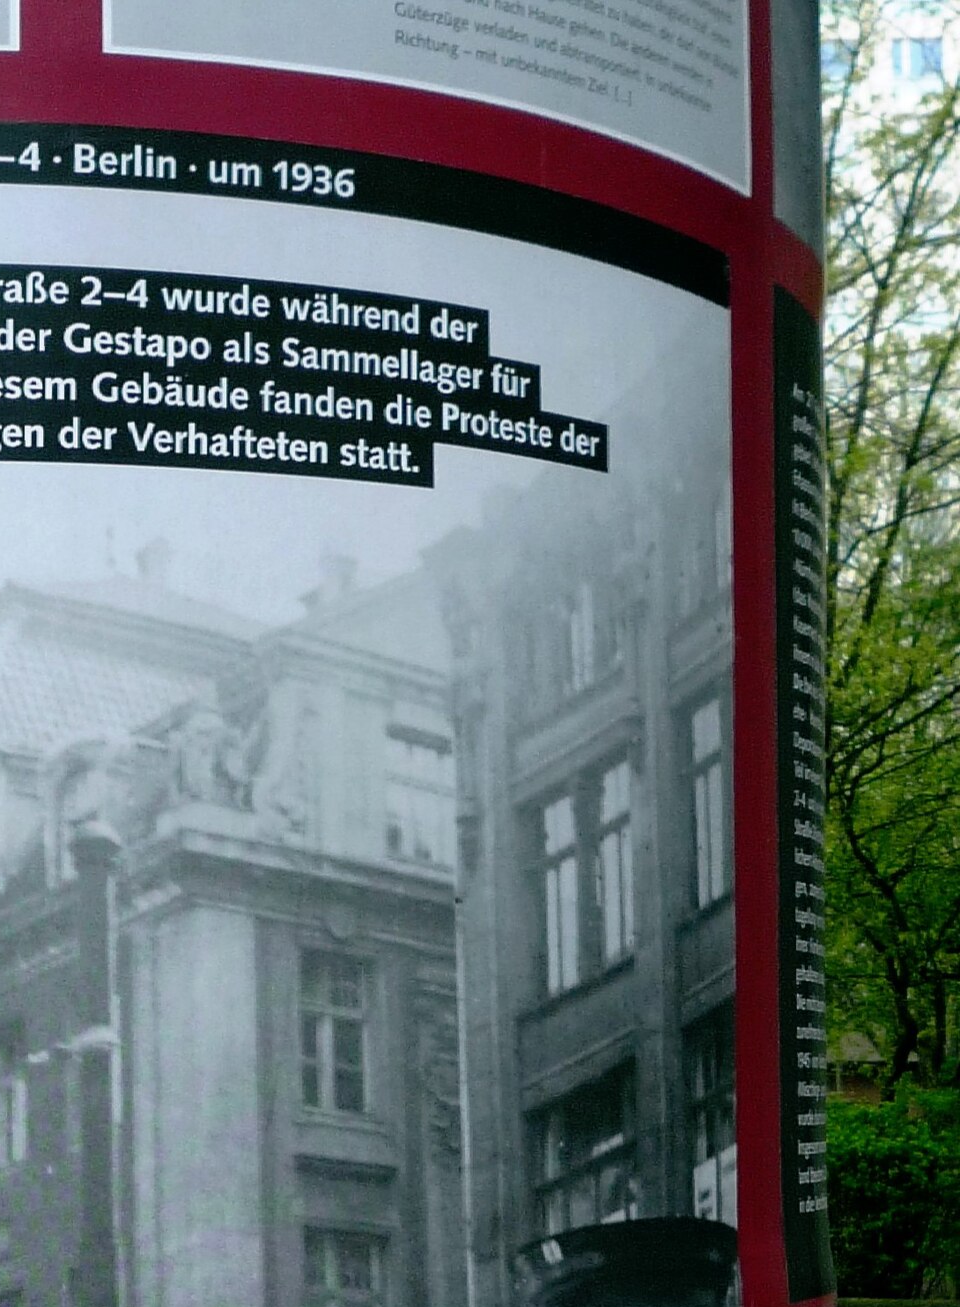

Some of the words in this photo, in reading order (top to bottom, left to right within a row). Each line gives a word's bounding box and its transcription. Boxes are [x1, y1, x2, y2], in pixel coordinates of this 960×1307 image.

[394, 2, 470, 33] Güterzüge
[474, 19, 529, 44] verladen
[533, 36, 557, 53] und
[394, 29, 460, 60] Richtung
[475, 49, 498, 65] mit
[73, 142, 177, 180] Berlin
[208, 159, 262, 188] um
[272, 160, 357, 198] 1936
[80, 275, 149, 309] 2–4
[160, 284, 270, 318] wurde
[280, 291, 420, 335] während
[429, 308, 479, 343] der
[62, 322, 212, 368] Gestapo
[222, 331, 271, 365] als
[280, 336, 484, 395] Sammellager
[490, 362, 531, 398] für
[91, 371, 250, 411] Gebäude
[258, 379, 374, 423] fanden
[383, 393, 433, 428] die
[440, 402, 553, 449] Proteste
[559, 422, 600, 458] der
[57, 416, 118, 451] der
[126, 420, 329, 464] Verhafteten
[339, 437, 421, 474] statt.
